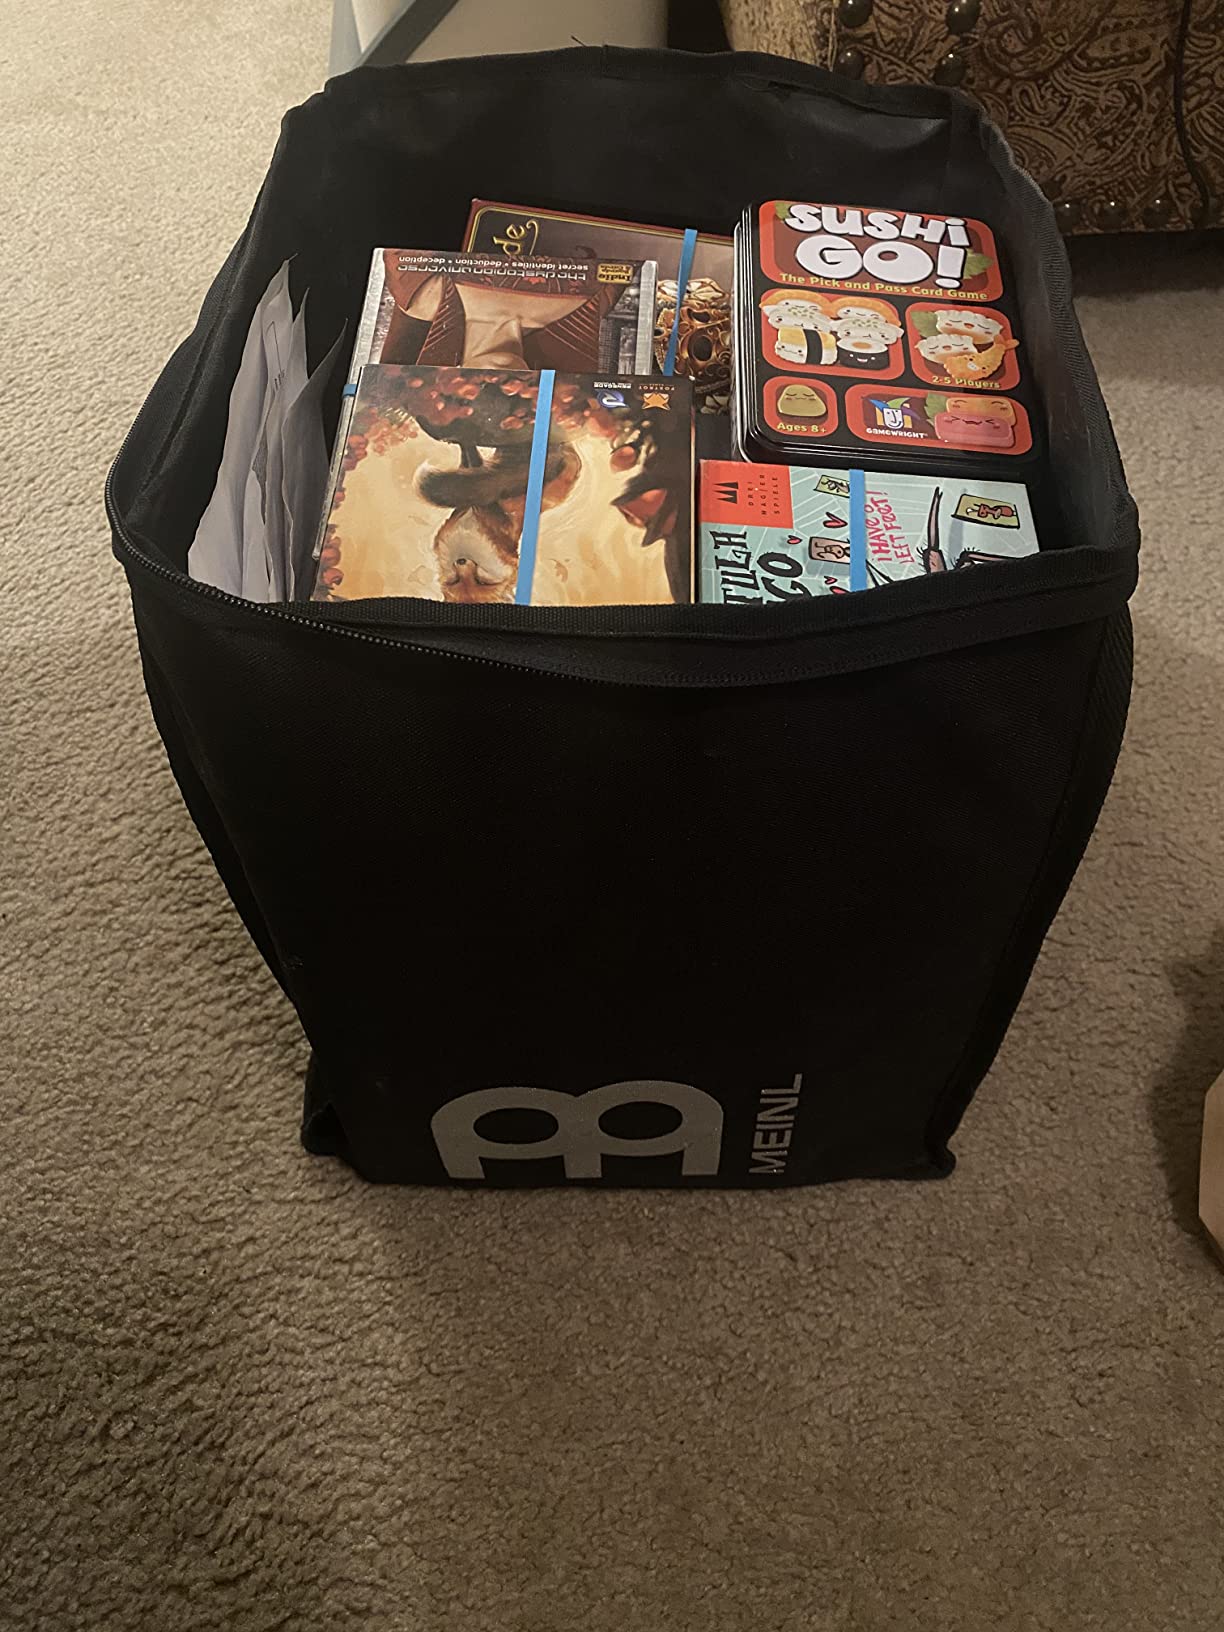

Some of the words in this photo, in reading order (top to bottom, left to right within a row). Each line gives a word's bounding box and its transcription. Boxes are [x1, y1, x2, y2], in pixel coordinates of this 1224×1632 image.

[398, 255, 446, 264] deception
[455, 258, 502, 267] deduction
[511, 261, 556, 271] identities
[795, 234, 966, 288] GO!
[557, 263, 589, 272] secret
[779, 272, 805, 284] The
[810, 275, 841, 288] Pick
[845, 279, 871, 291] and
[875, 282, 908, 294] Pass
[911, 285, 943, 297] Card
[948, 288, 988, 300] Game
[932, 374, 951, 385] 2-5
[955, 376, 1001, 390] Players
[776, 421, 808, 434] Ages
[811, 424, 828, 435] 8+
[772, 476, 780, 515] SPIELE
[749, 1073, 804, 1174] MEINL
